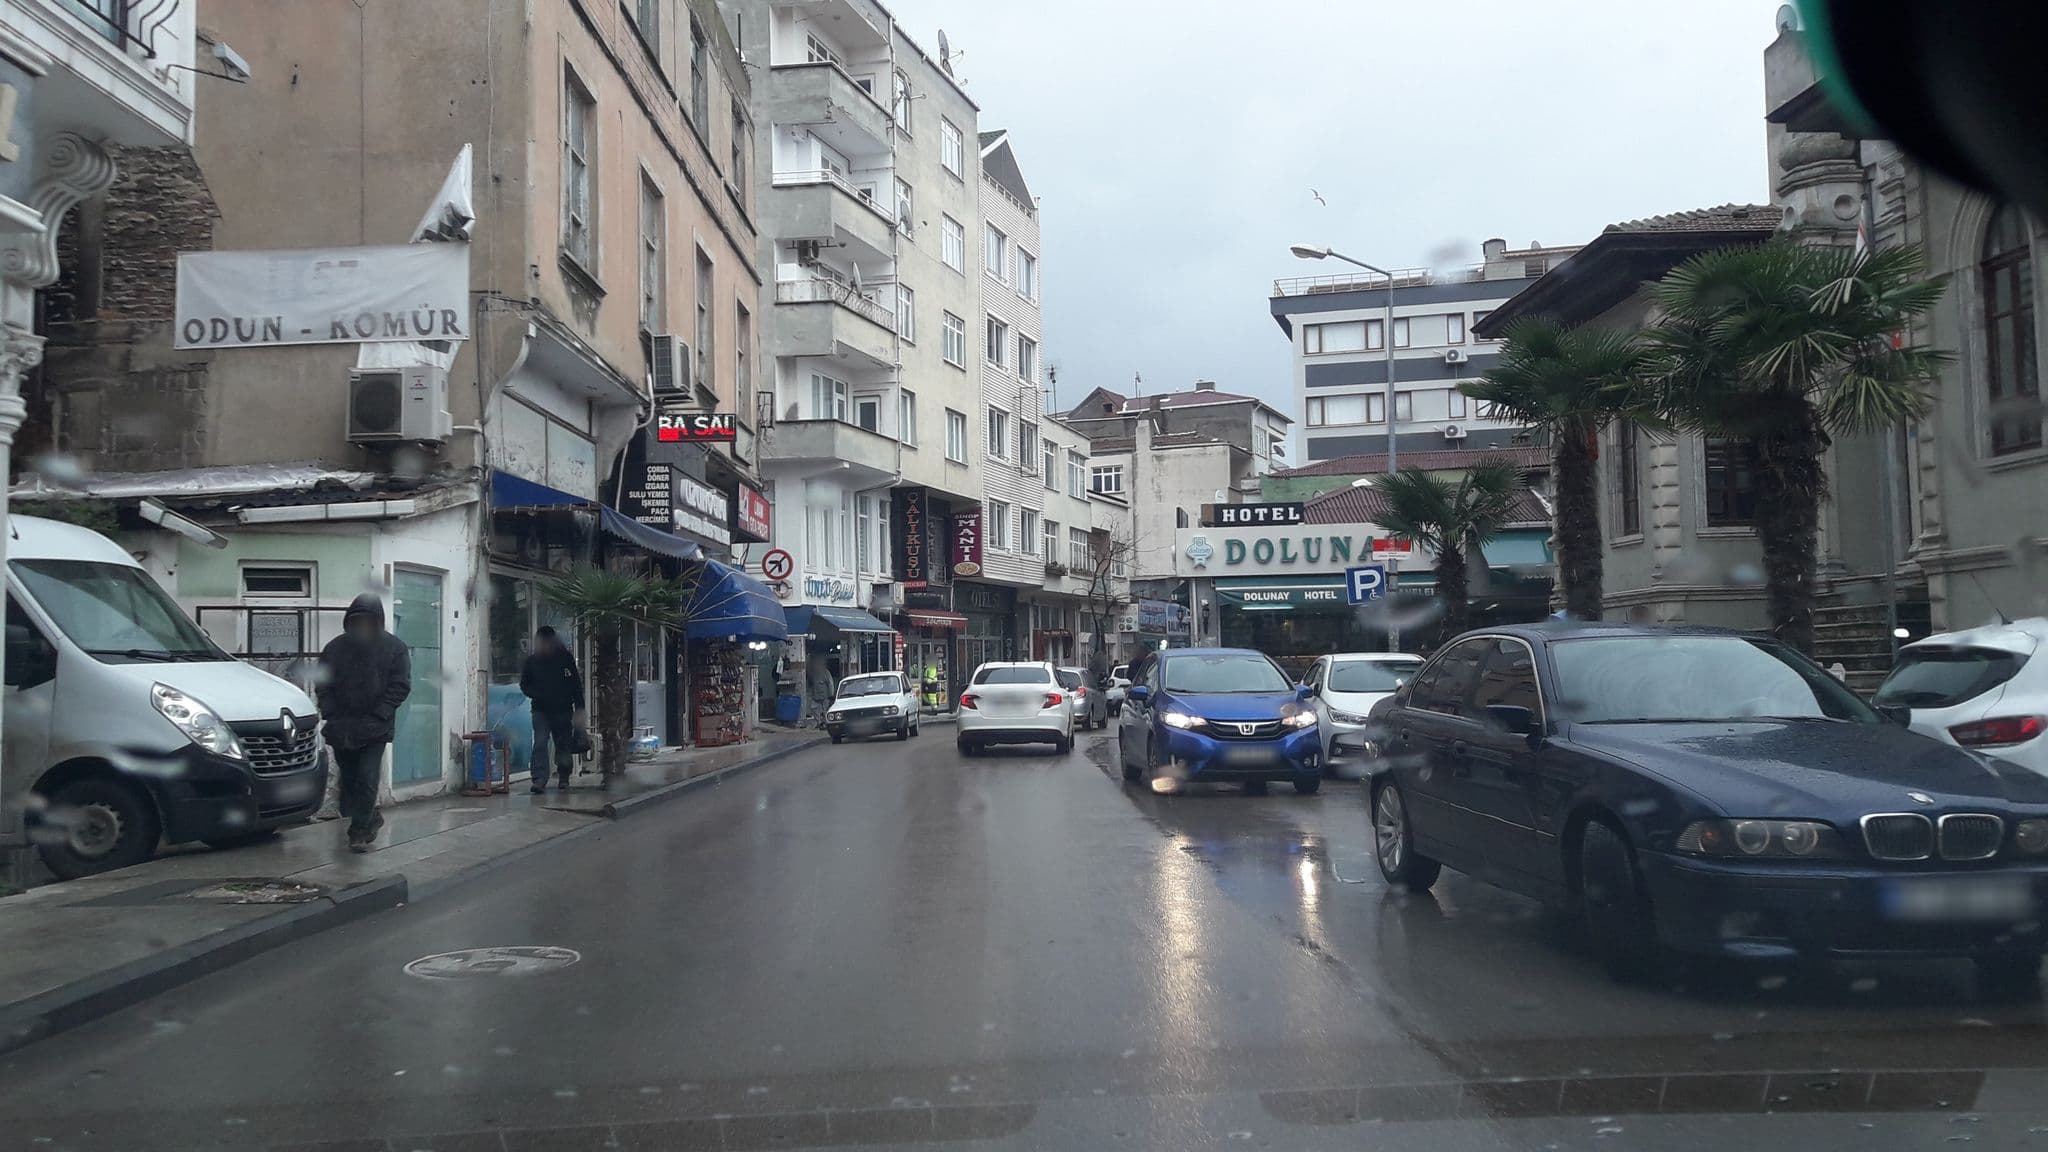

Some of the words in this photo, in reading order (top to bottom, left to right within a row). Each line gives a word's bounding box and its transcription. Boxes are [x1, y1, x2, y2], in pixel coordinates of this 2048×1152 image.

[183, 316, 282, 344] ODUN
[650, 508, 670, 516] PAÇA
[1222, 507, 1300, 522] HOTEL
[958, 519, 976, 562] MANTI
[1224, 535, 1375, 565] DOLUNA
[1243, 592, 1290, 601] DOLUNAY
[1304, 590, 1338, 600] HOTEL
[1354, 569, 1381, 600] P
